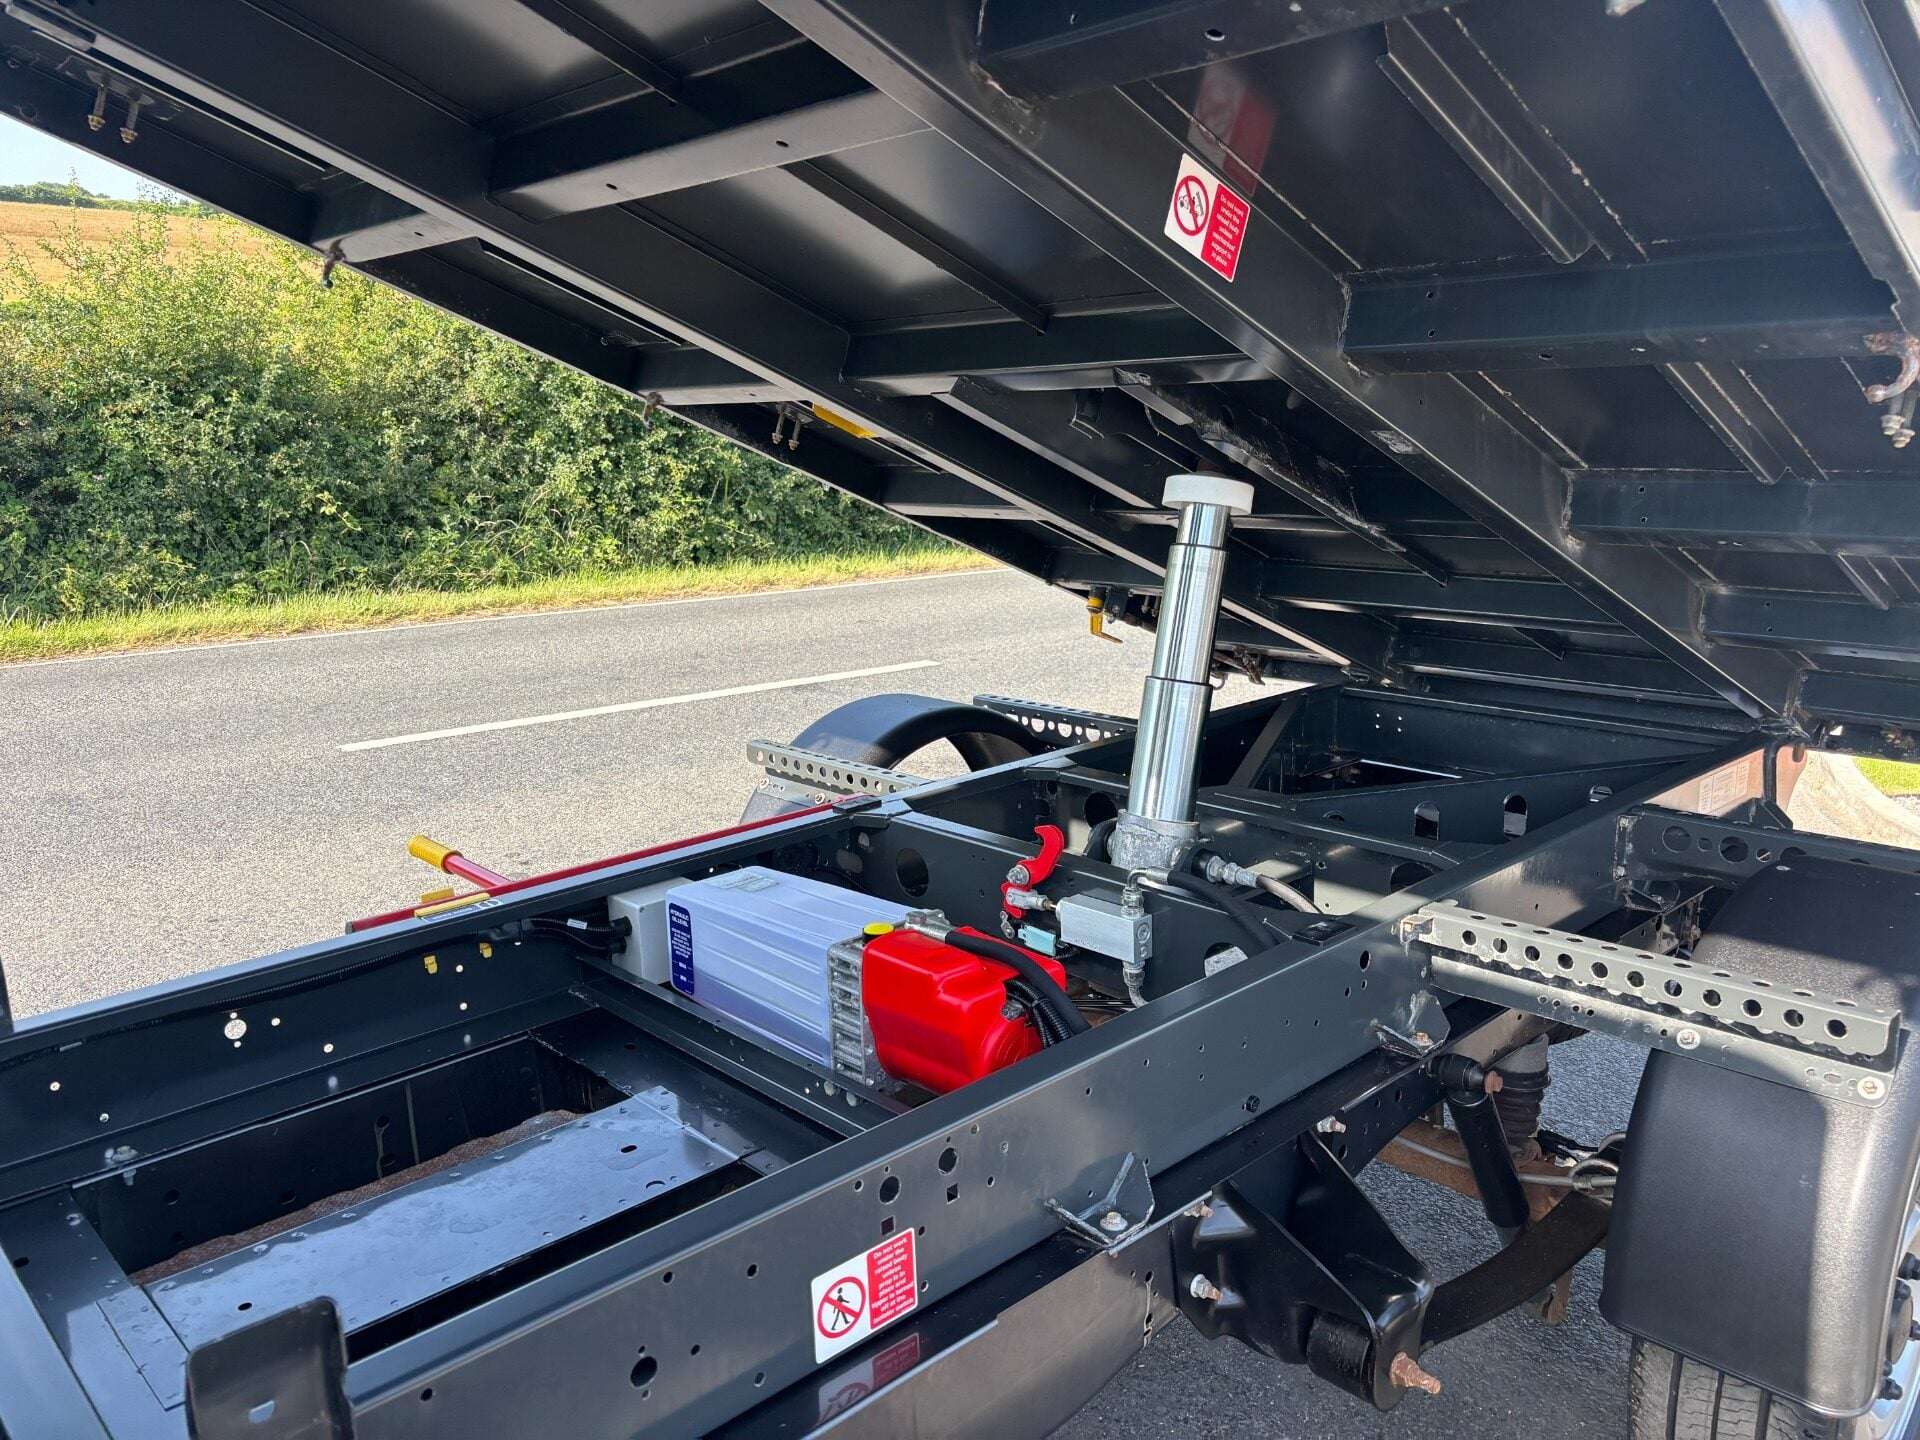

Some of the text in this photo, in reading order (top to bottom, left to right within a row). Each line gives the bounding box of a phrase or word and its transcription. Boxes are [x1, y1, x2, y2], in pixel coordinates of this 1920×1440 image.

[1221, 194, 1226, 203] Do
[874, 1237, 907, 1259] Do not work
[877, 1247, 904, 1265] under the
[874, 1253, 907, 1275] raised body
[882, 1265, 901, 1279] unless
